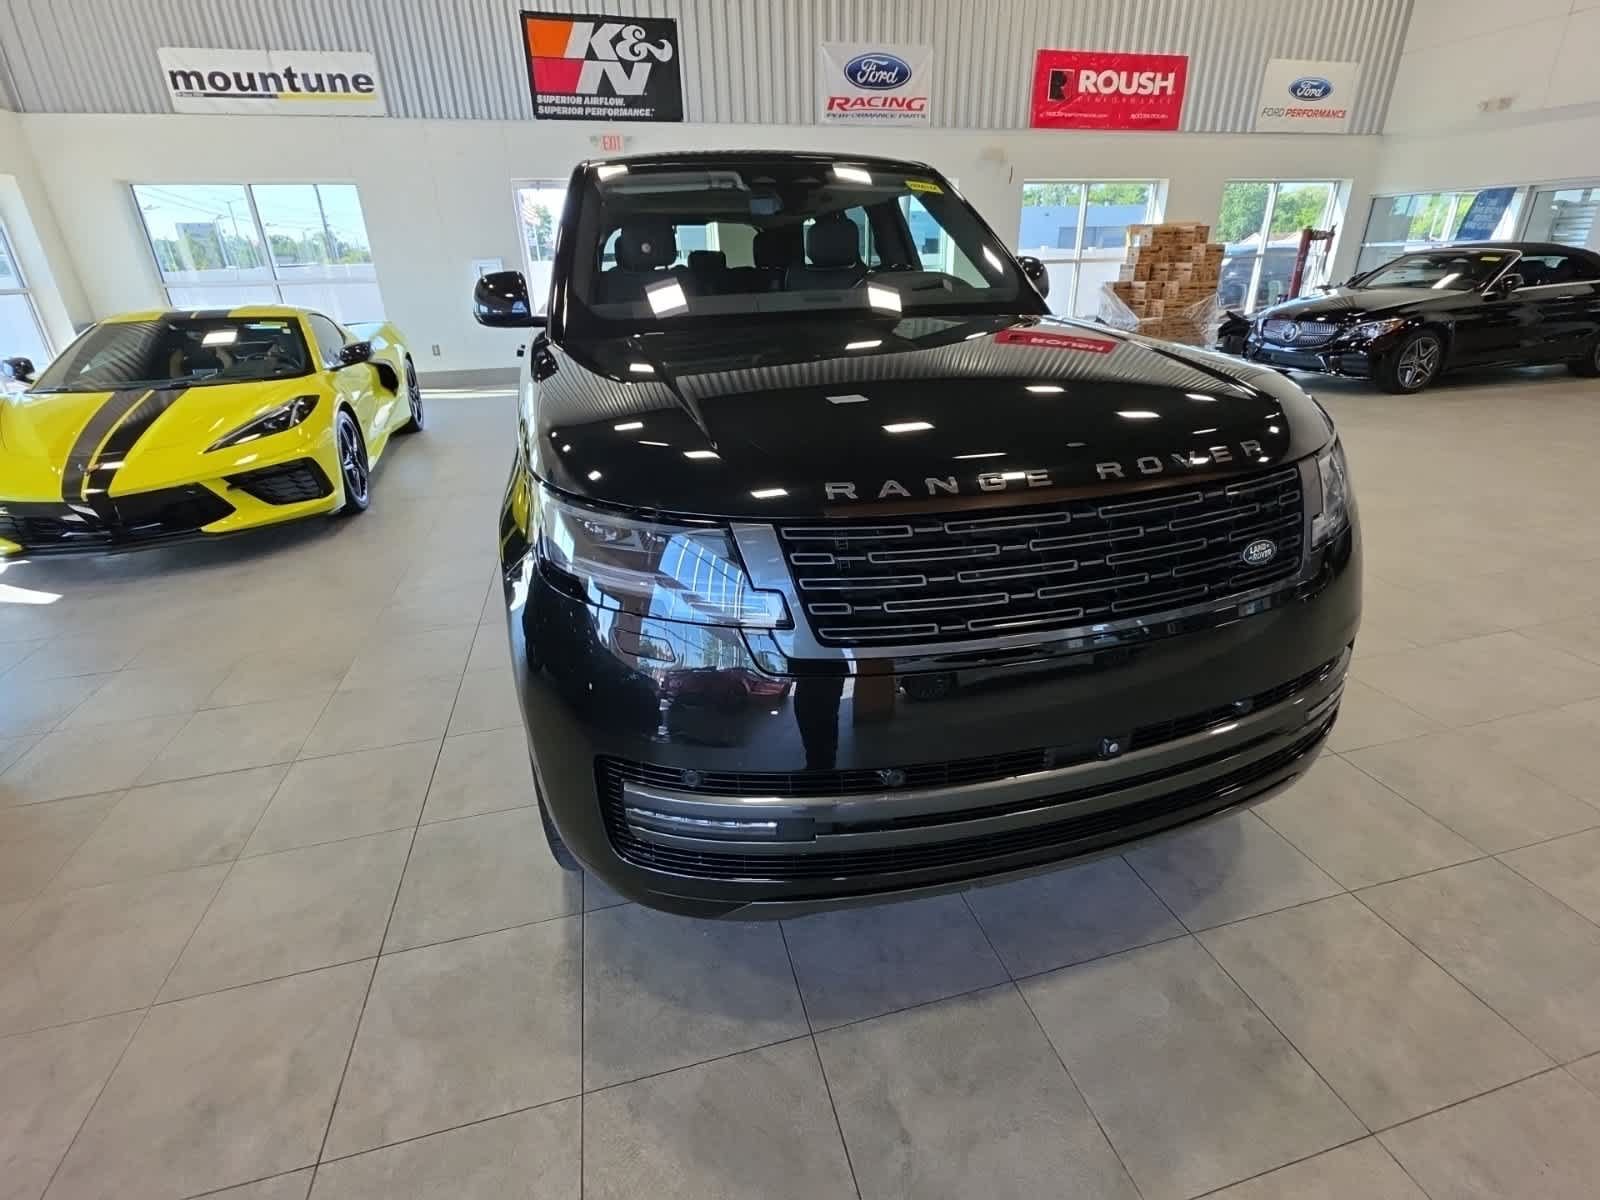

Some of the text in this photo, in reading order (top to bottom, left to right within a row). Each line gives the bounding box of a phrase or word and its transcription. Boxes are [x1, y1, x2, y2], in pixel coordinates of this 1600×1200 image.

[168, 66, 375, 93] mountune
[857, 58, 898, 84] Ford
[1078, 69, 1175, 95] ROUSH
[1296, 80, 1325, 97] Ford
[536, 95, 583, 105] SUPERIOR
[827, 96, 928, 111] RACING
[538, 105, 584, 115] SUPERIOR
[1262, 107, 1346, 119] FORD PERFORMANCE
[824, 440, 1265, 500] RANGE ROVER
